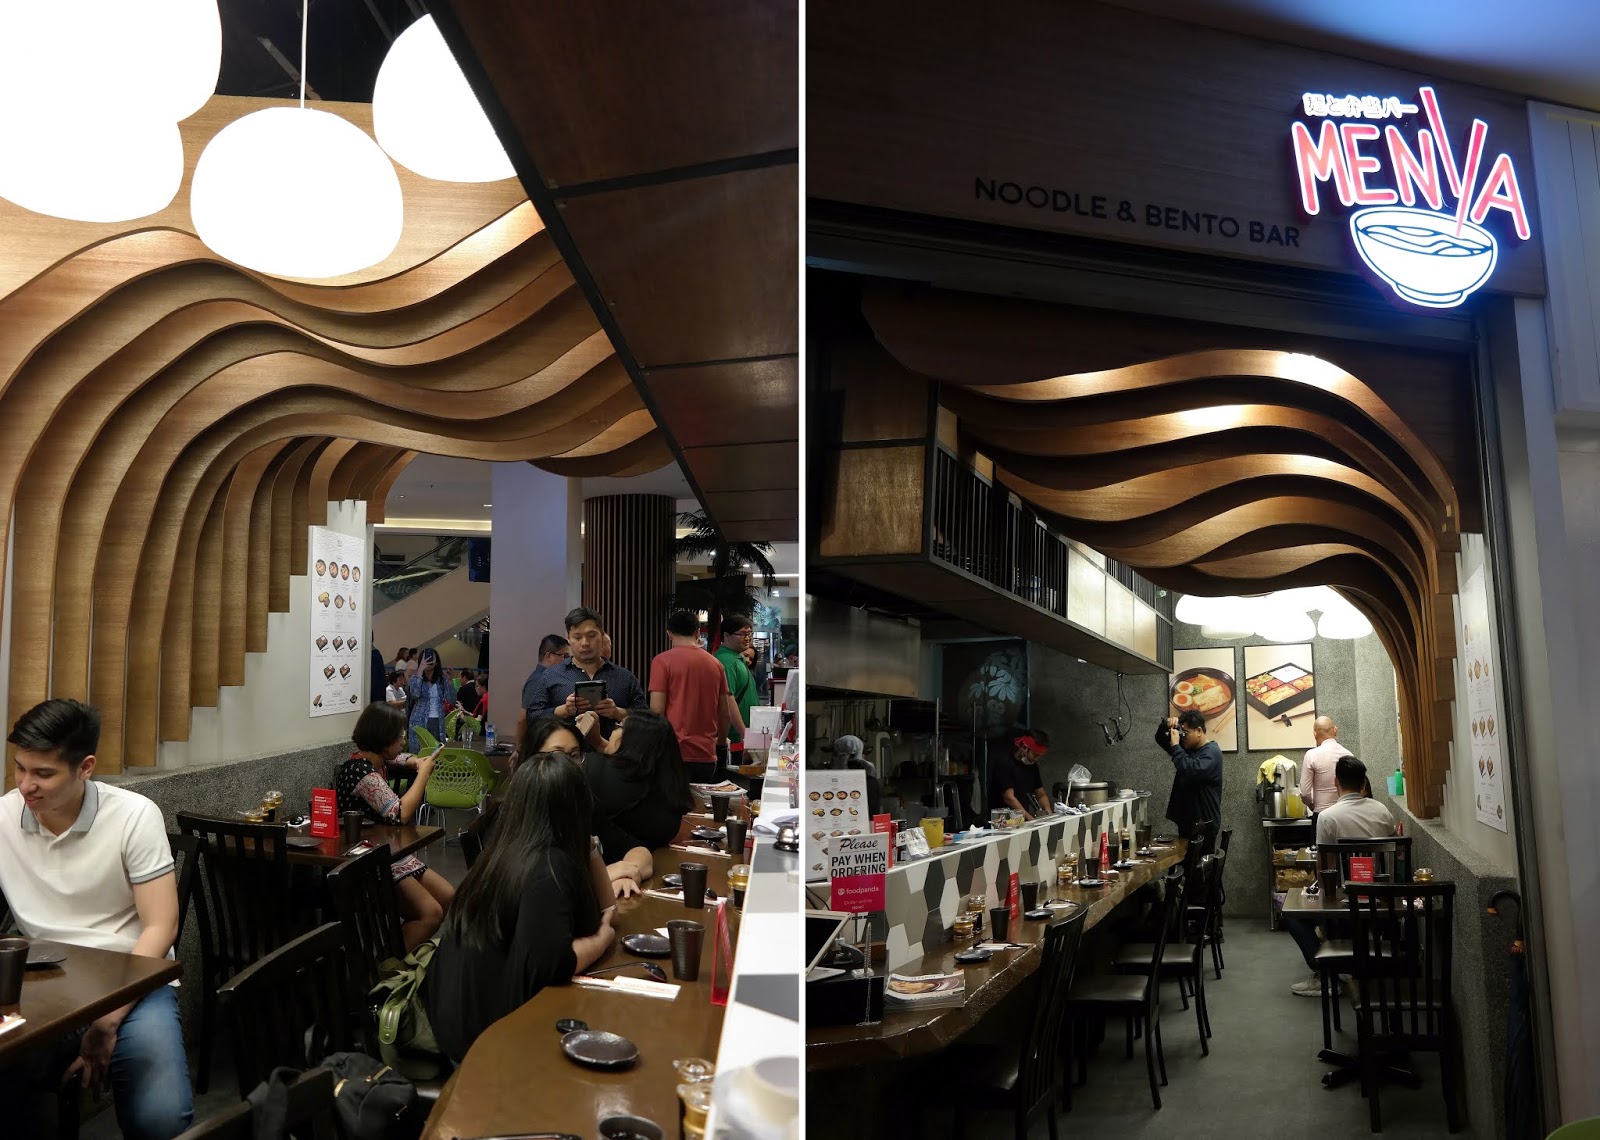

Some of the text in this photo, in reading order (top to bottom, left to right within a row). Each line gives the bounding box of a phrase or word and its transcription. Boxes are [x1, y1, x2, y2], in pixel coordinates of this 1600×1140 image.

[1292, 87, 1531, 240] MENYA
[974, 176, 1300, 248] NOODLE & BENTO BAR
[839, 838, 879, 851] Please
[831, 851, 886, 867] PAY WHEN
[830, 863, 886, 878] ORDERING
[846, 886, 880, 895] foodpanda
